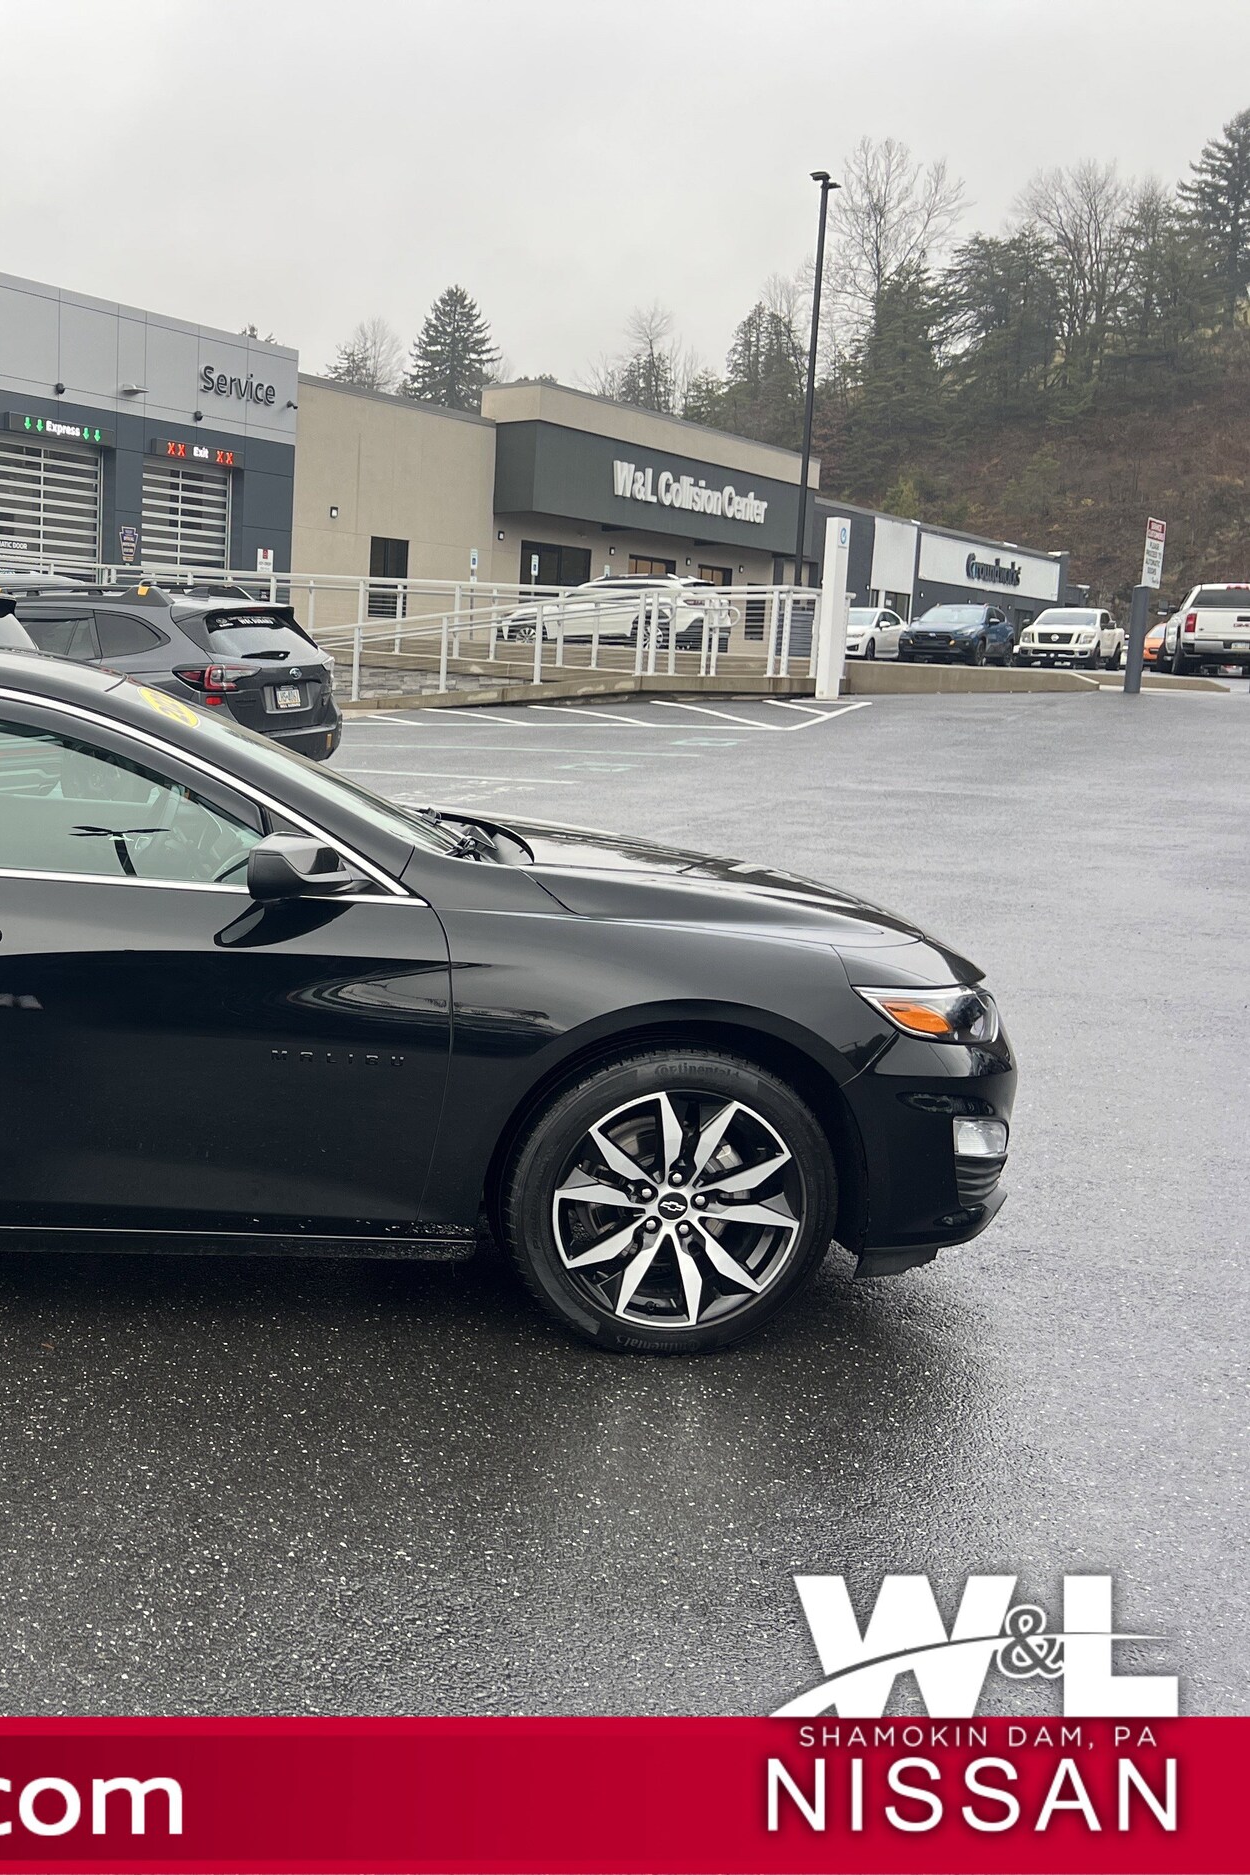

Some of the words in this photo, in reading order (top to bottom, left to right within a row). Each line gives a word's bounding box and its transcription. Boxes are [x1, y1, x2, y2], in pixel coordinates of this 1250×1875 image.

[201, 364, 277, 406] Service
[45, 420, 81, 437] Express
[193, 446, 209, 459] Exit
[613, 460, 657, 503] W&L
[658, 471, 722, 516] Collision
[722, 485, 768, 524] Center
[12, 542, 28, 550] DOOR
[271, 1049, 405, 1067] MALIBU
[654, 1062, 732, 1077] Continental
